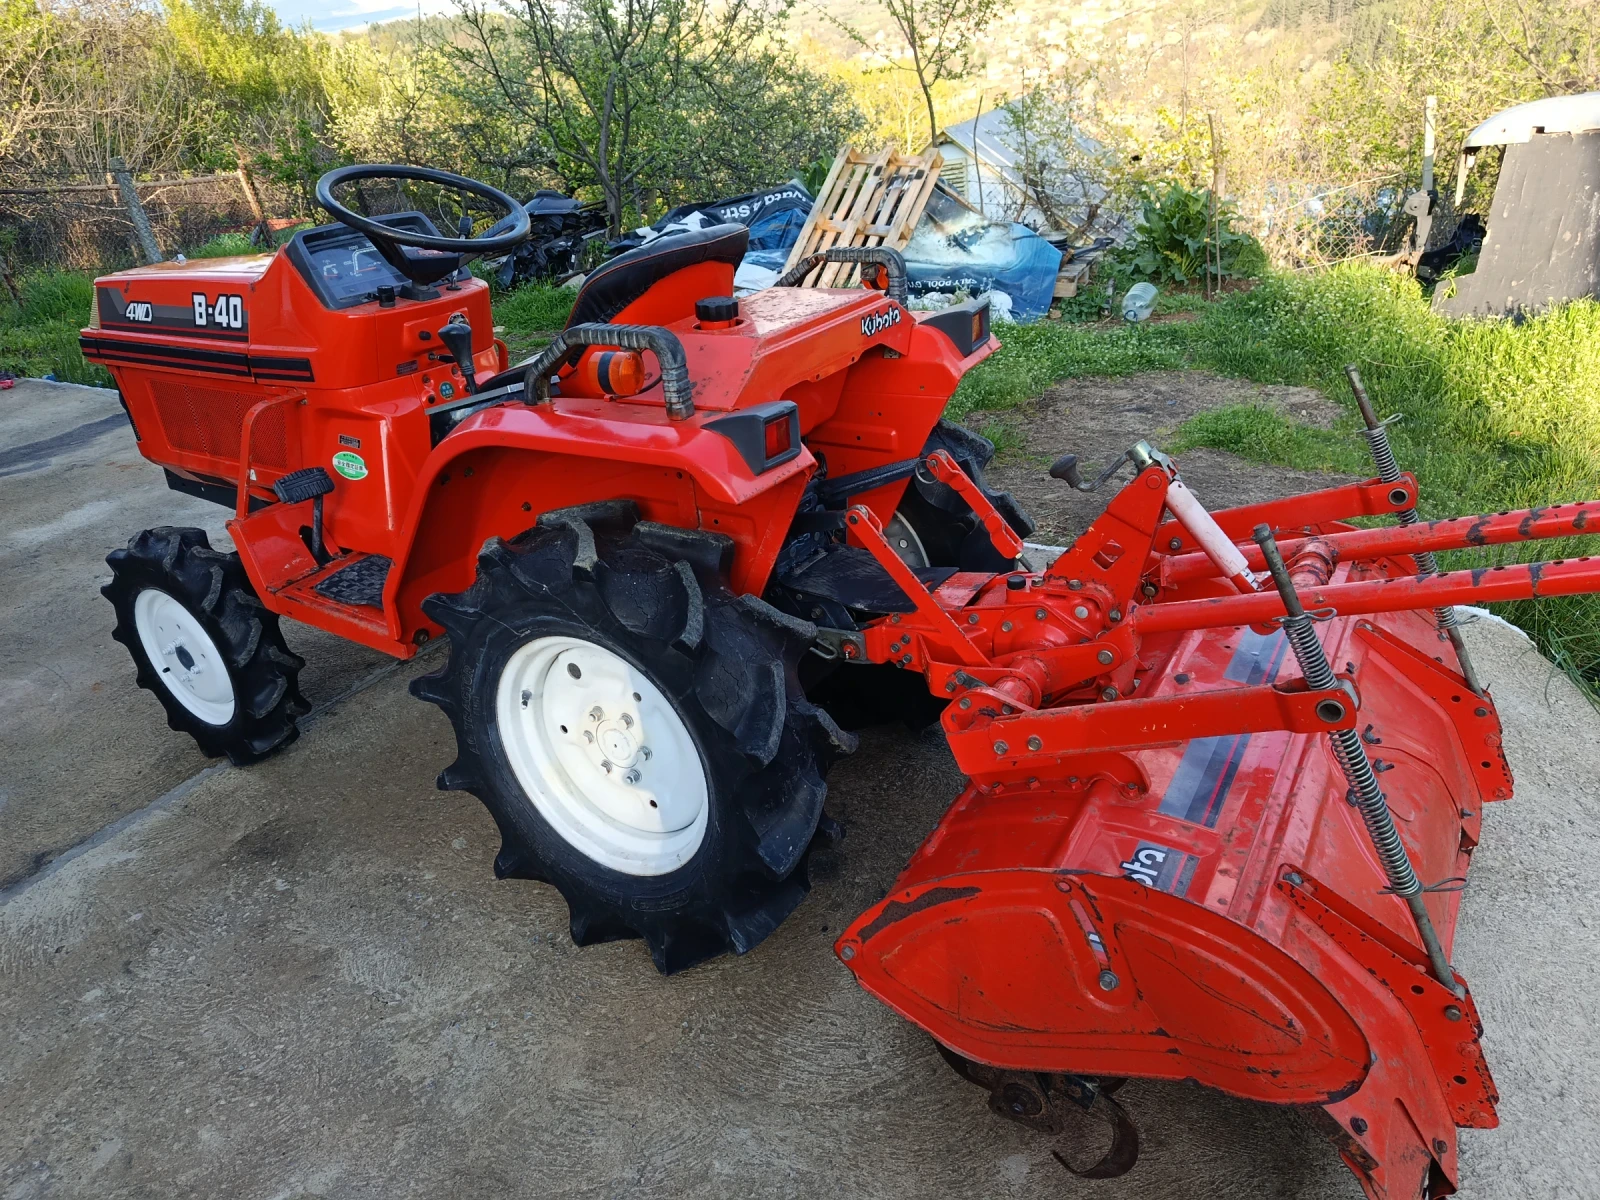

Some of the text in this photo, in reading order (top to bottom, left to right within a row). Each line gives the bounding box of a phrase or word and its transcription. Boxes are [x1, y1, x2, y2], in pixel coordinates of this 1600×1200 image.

[720, 205, 751, 219] Str.
[125, 301, 152, 323] 4WD
[861, 304, 900, 337] Kubota
[462, 664, 475, 729] TRACTOR
